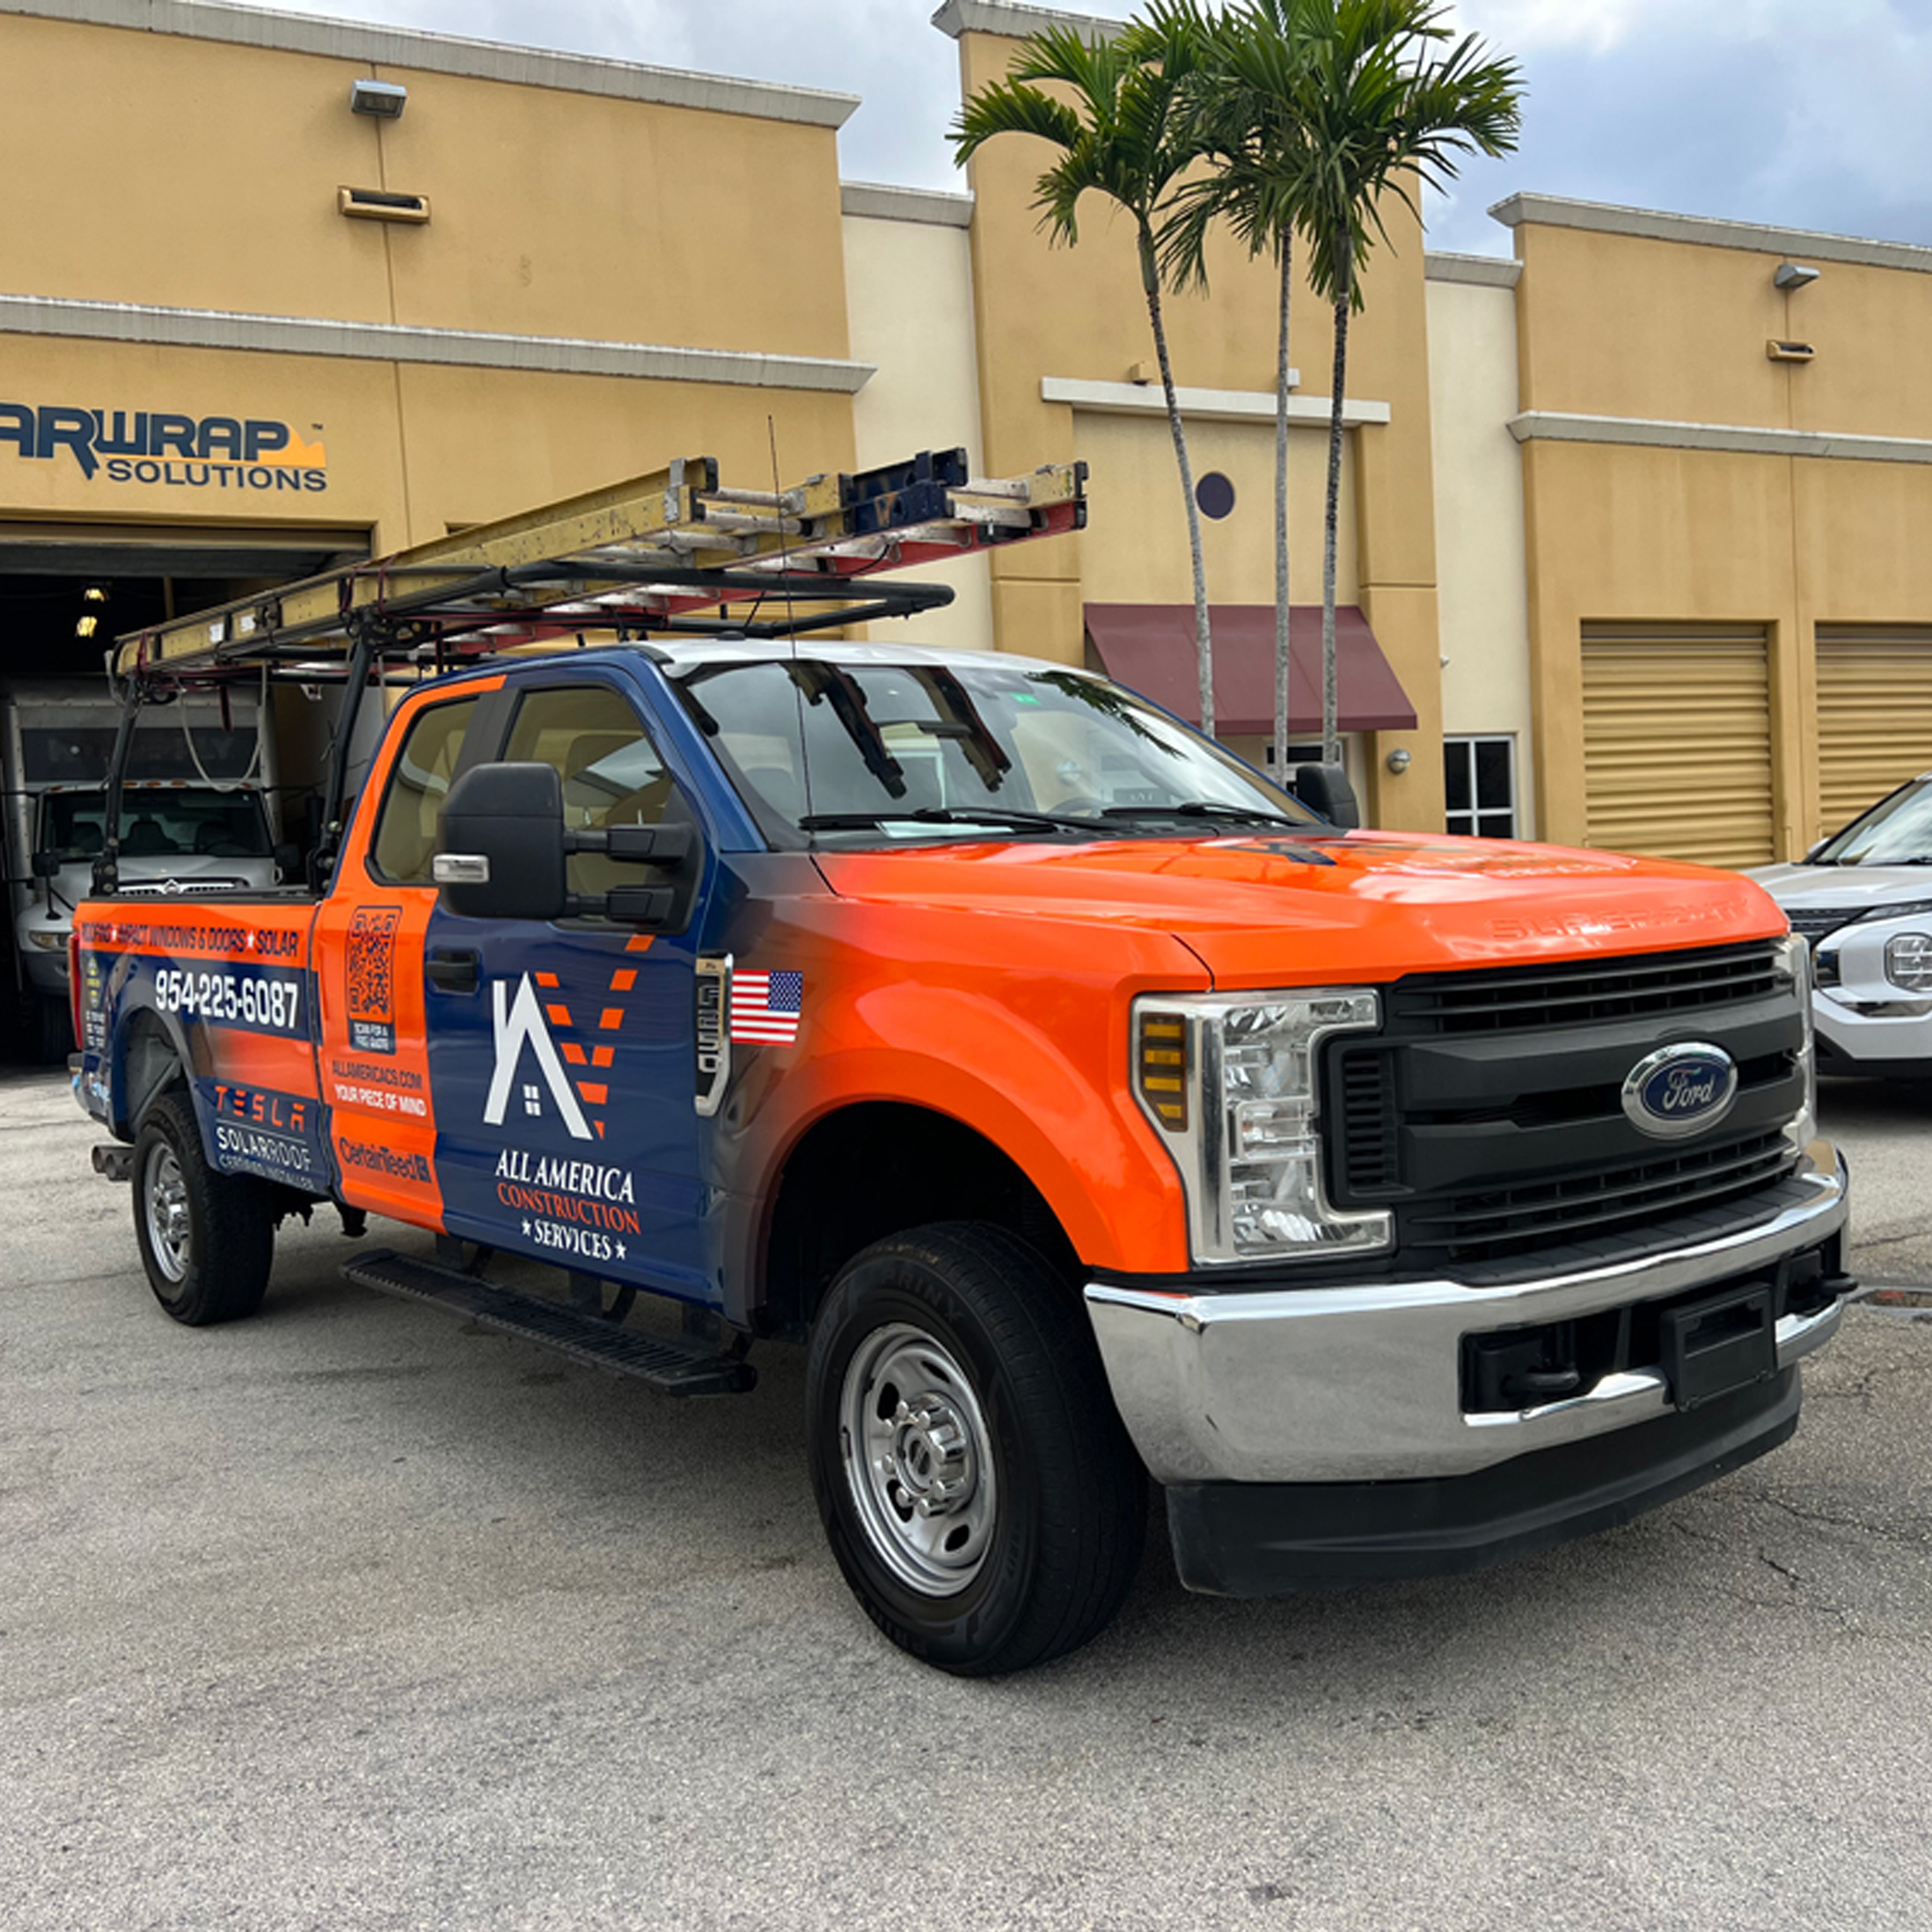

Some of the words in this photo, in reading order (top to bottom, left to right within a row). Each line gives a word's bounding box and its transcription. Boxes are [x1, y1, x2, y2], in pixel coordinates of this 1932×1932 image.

[107, 459, 327, 492] SOLUTIONS
[149, 925, 197, 949] WINDOWS
[208, 927, 246, 953] DOORS
[256, 929, 299, 957] SOLAR
[156, 970, 298, 1029] 954-225-6087
[215, 1085, 305, 1133] TESLA
[334, 1083, 357, 1102] YOUR
[385, 1092, 397, 1110] OF
[398, 1095, 427, 1116] MIND
[1663, 1067, 1715, 1110] Ford
[495, 1148, 530, 1183] ALL
[534, 1156, 636, 1204] AMERICA
[496, 1182, 641, 1235] CONSTRUCTION
[534, 1218, 612, 1261] SERVICES
